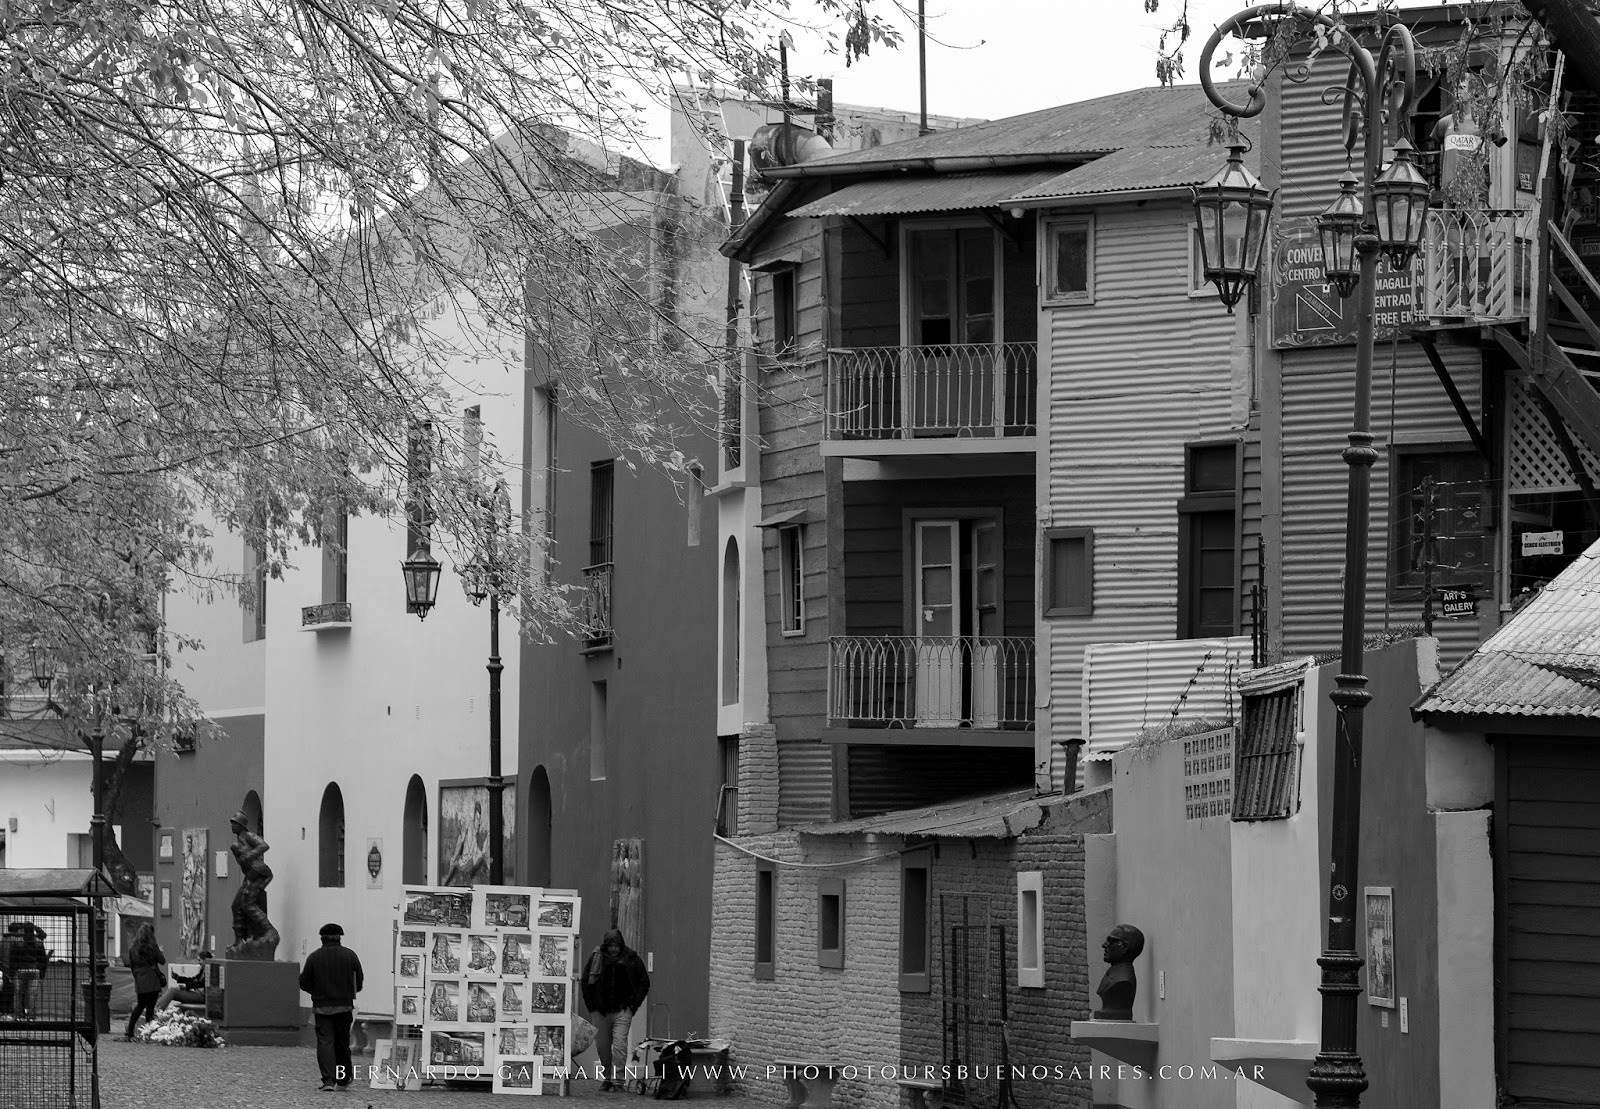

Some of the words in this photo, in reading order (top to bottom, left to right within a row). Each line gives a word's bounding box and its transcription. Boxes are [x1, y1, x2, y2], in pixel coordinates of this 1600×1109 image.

[1450, 136, 1474, 145] QATAR
[1288, 267, 1320, 281] CENTRO
[1304, 293, 1331, 318] CAMINITO
[1375, 311, 1398, 325] FREE
[1444, 601, 1474, 612] GALERY
